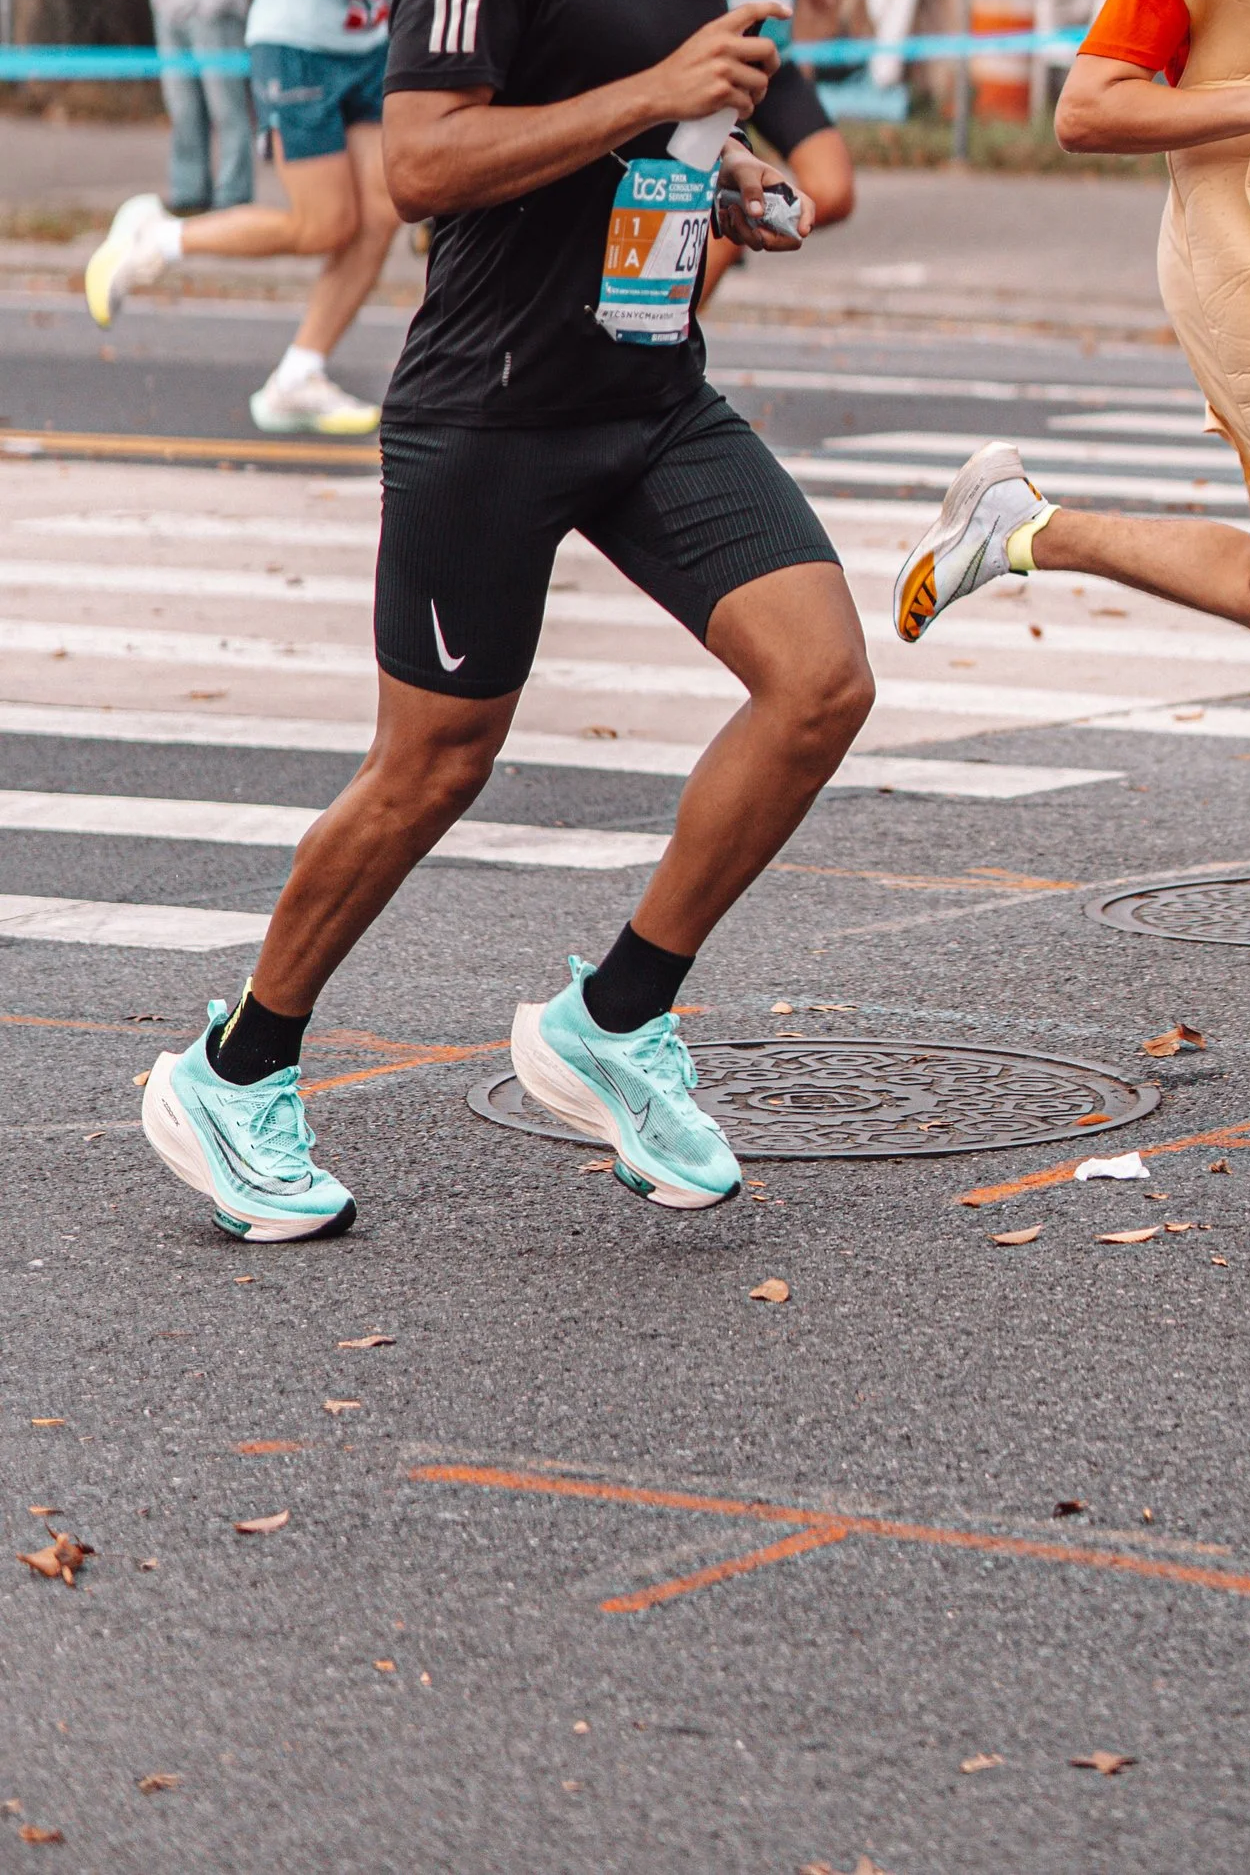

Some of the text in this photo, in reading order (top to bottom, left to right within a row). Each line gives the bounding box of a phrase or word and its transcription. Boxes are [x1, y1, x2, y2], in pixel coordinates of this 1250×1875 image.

[671, 173, 687, 183] TATA
[634, 172, 667, 202] tcs
[668, 183, 704, 193] CONSULTANCY
[668, 192, 692, 203] SERVICES
[632, 217, 641, 237] 1
[624, 248, 640, 268] A
